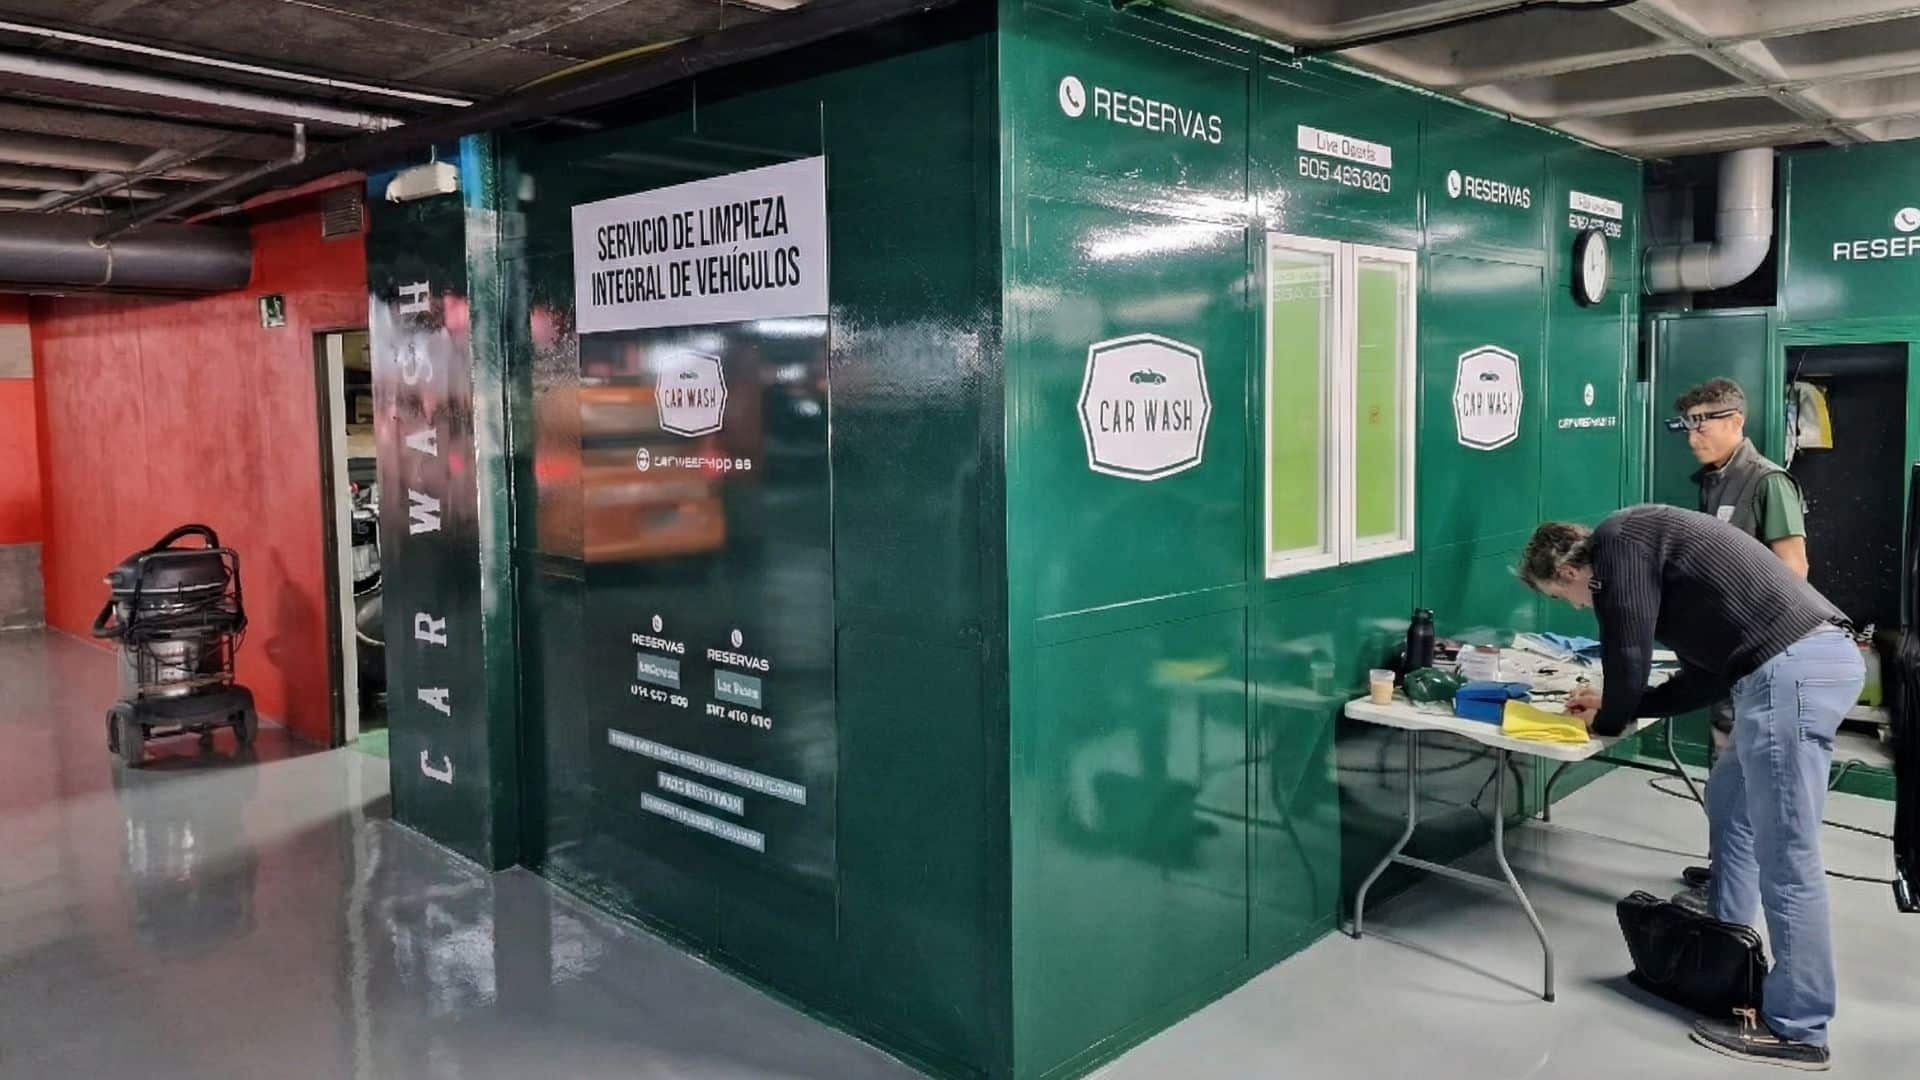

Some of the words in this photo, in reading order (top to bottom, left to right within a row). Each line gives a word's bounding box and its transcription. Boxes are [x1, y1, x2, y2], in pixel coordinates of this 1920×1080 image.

[1093, 86, 1223, 145] RESERVAS
[1465, 175, 1531, 209] RESERVAS
[597, 214, 669, 261] SERVICIO
[672, 210, 695, 250] DE
[699, 195, 789, 247] LIMPIEZA
[592, 263, 666, 306] INTEGRAL
[670, 259, 693, 298] DE
[695, 246, 801, 296] VEHÍCULOS
[397, 279, 442, 537] WASH
[664, 389, 683, 409] CAR
[686, 387, 717, 408] WASH
[1463, 392, 1483, 417] CAR
[1486, 392, 1514, 416] WASH
[1099, 400, 1136, 433] CAR
[1144, 399, 1193, 432] WASH
[631, 633, 686, 654] RESERVAS
[706, 648, 770, 672] RESERVAS
[414, 611, 454, 784] CAR
